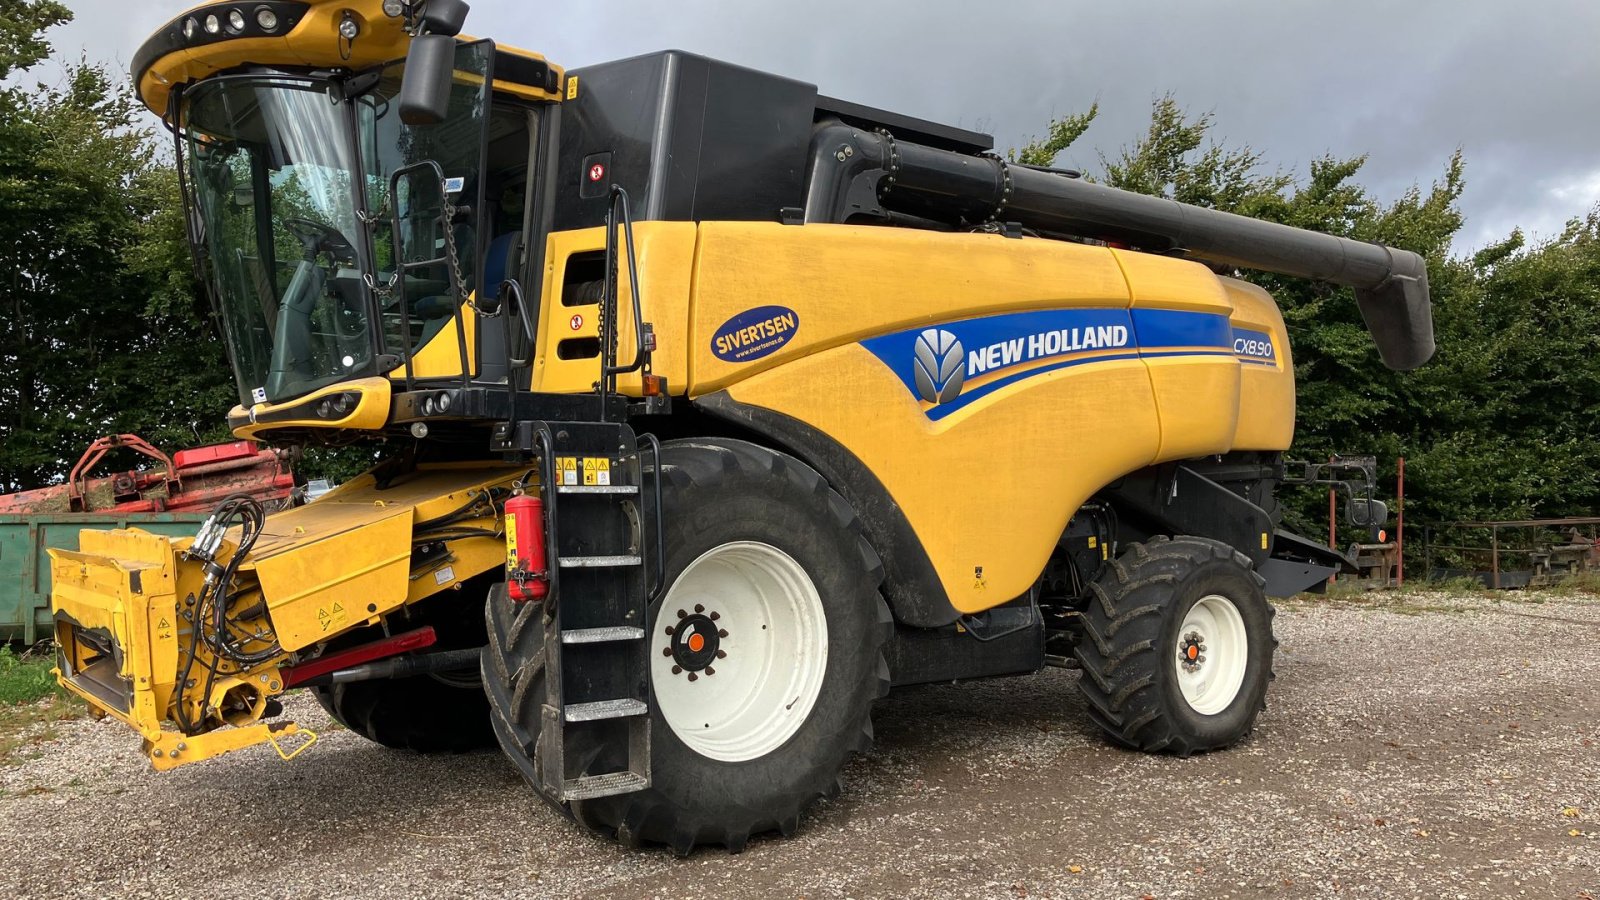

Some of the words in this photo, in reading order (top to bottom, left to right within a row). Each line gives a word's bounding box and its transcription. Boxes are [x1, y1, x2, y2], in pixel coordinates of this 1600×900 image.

[716, 312, 795, 354] SIVERTSEN
[968, 338, 1024, 376] NEW
[1028, 325, 1128, 358] HOLLAND
[1234, 338, 1272, 357] CX8.90
